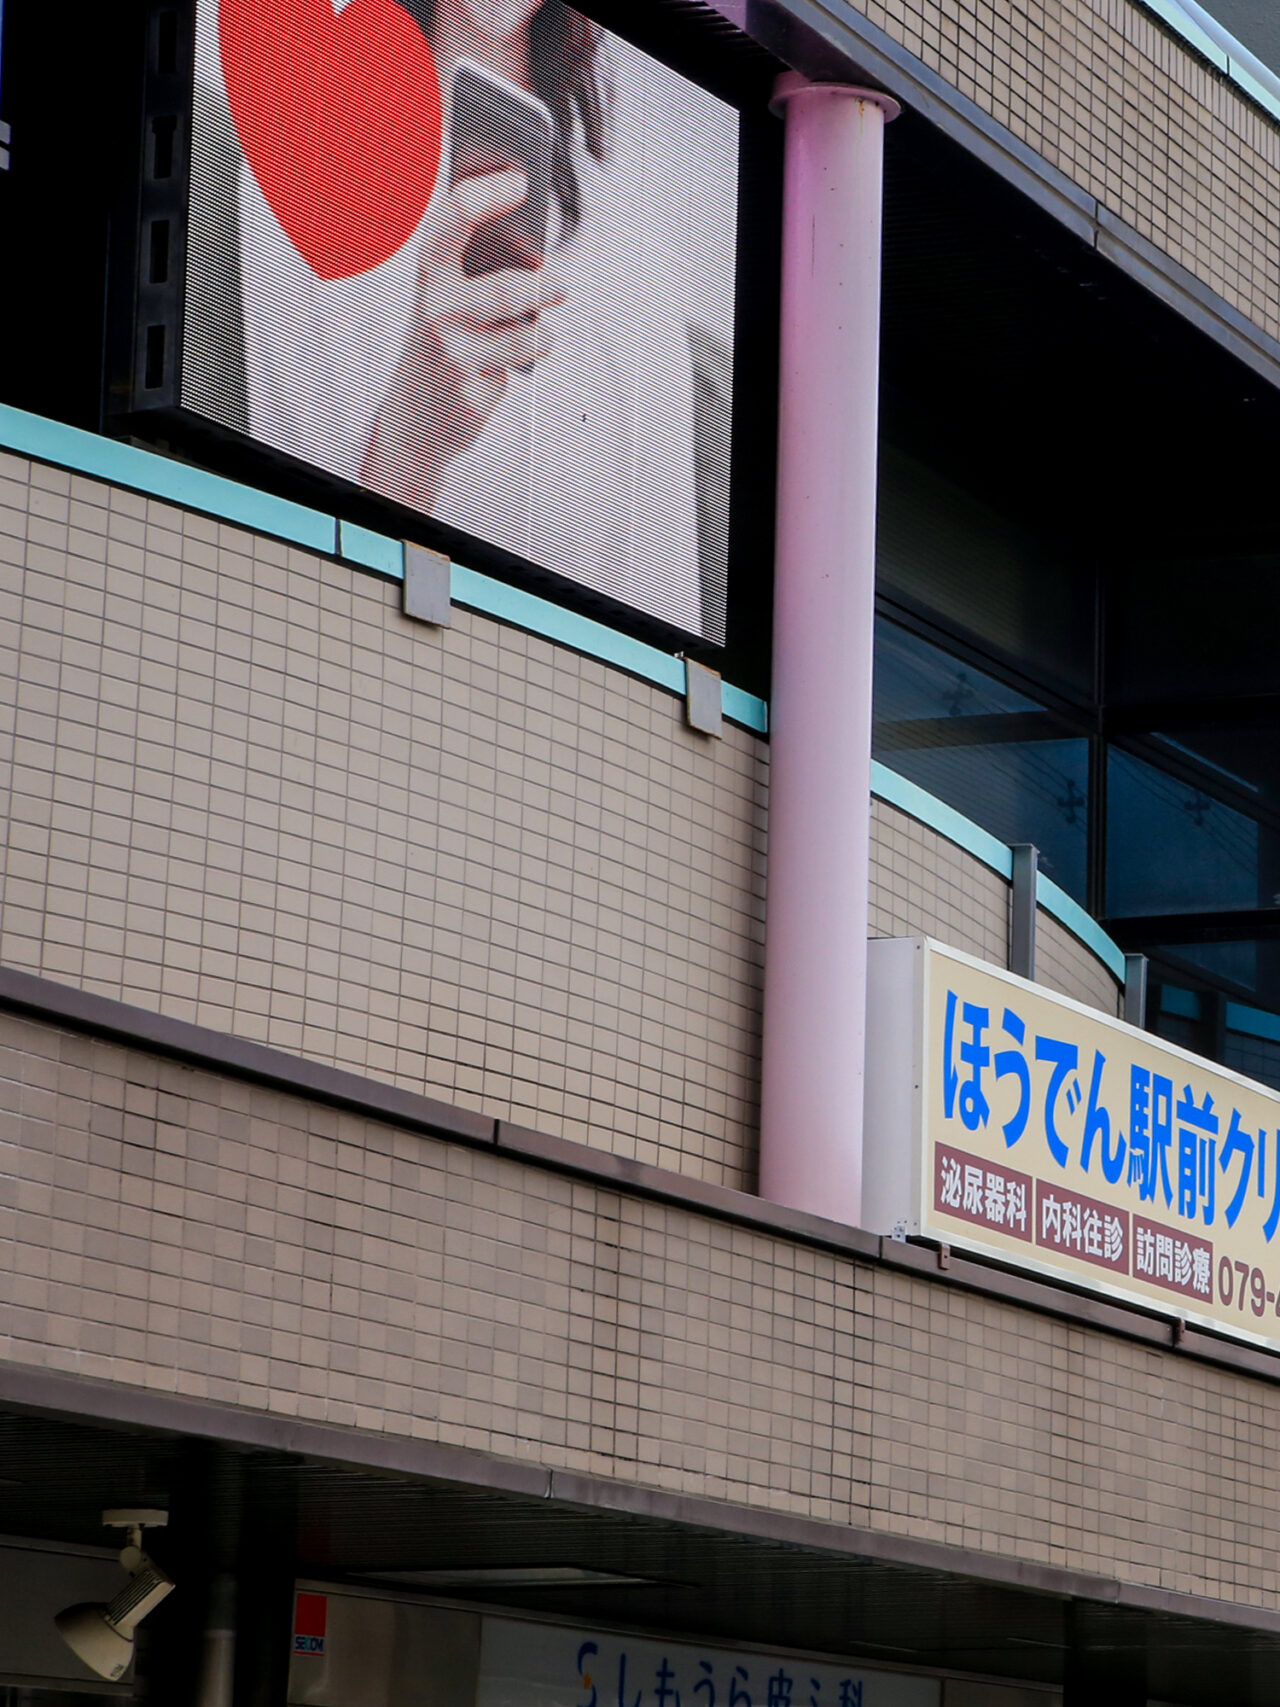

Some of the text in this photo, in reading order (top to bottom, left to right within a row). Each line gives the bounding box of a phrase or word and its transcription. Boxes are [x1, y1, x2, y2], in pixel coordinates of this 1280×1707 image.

[940, 1155, 1027, 1232] 泌尿器科
[1041, 1194, 1124, 1262] 内科往診
[1136, 1226, 1211, 1294] 訪問診療
[295, 1635, 324, 1653] SECOM
